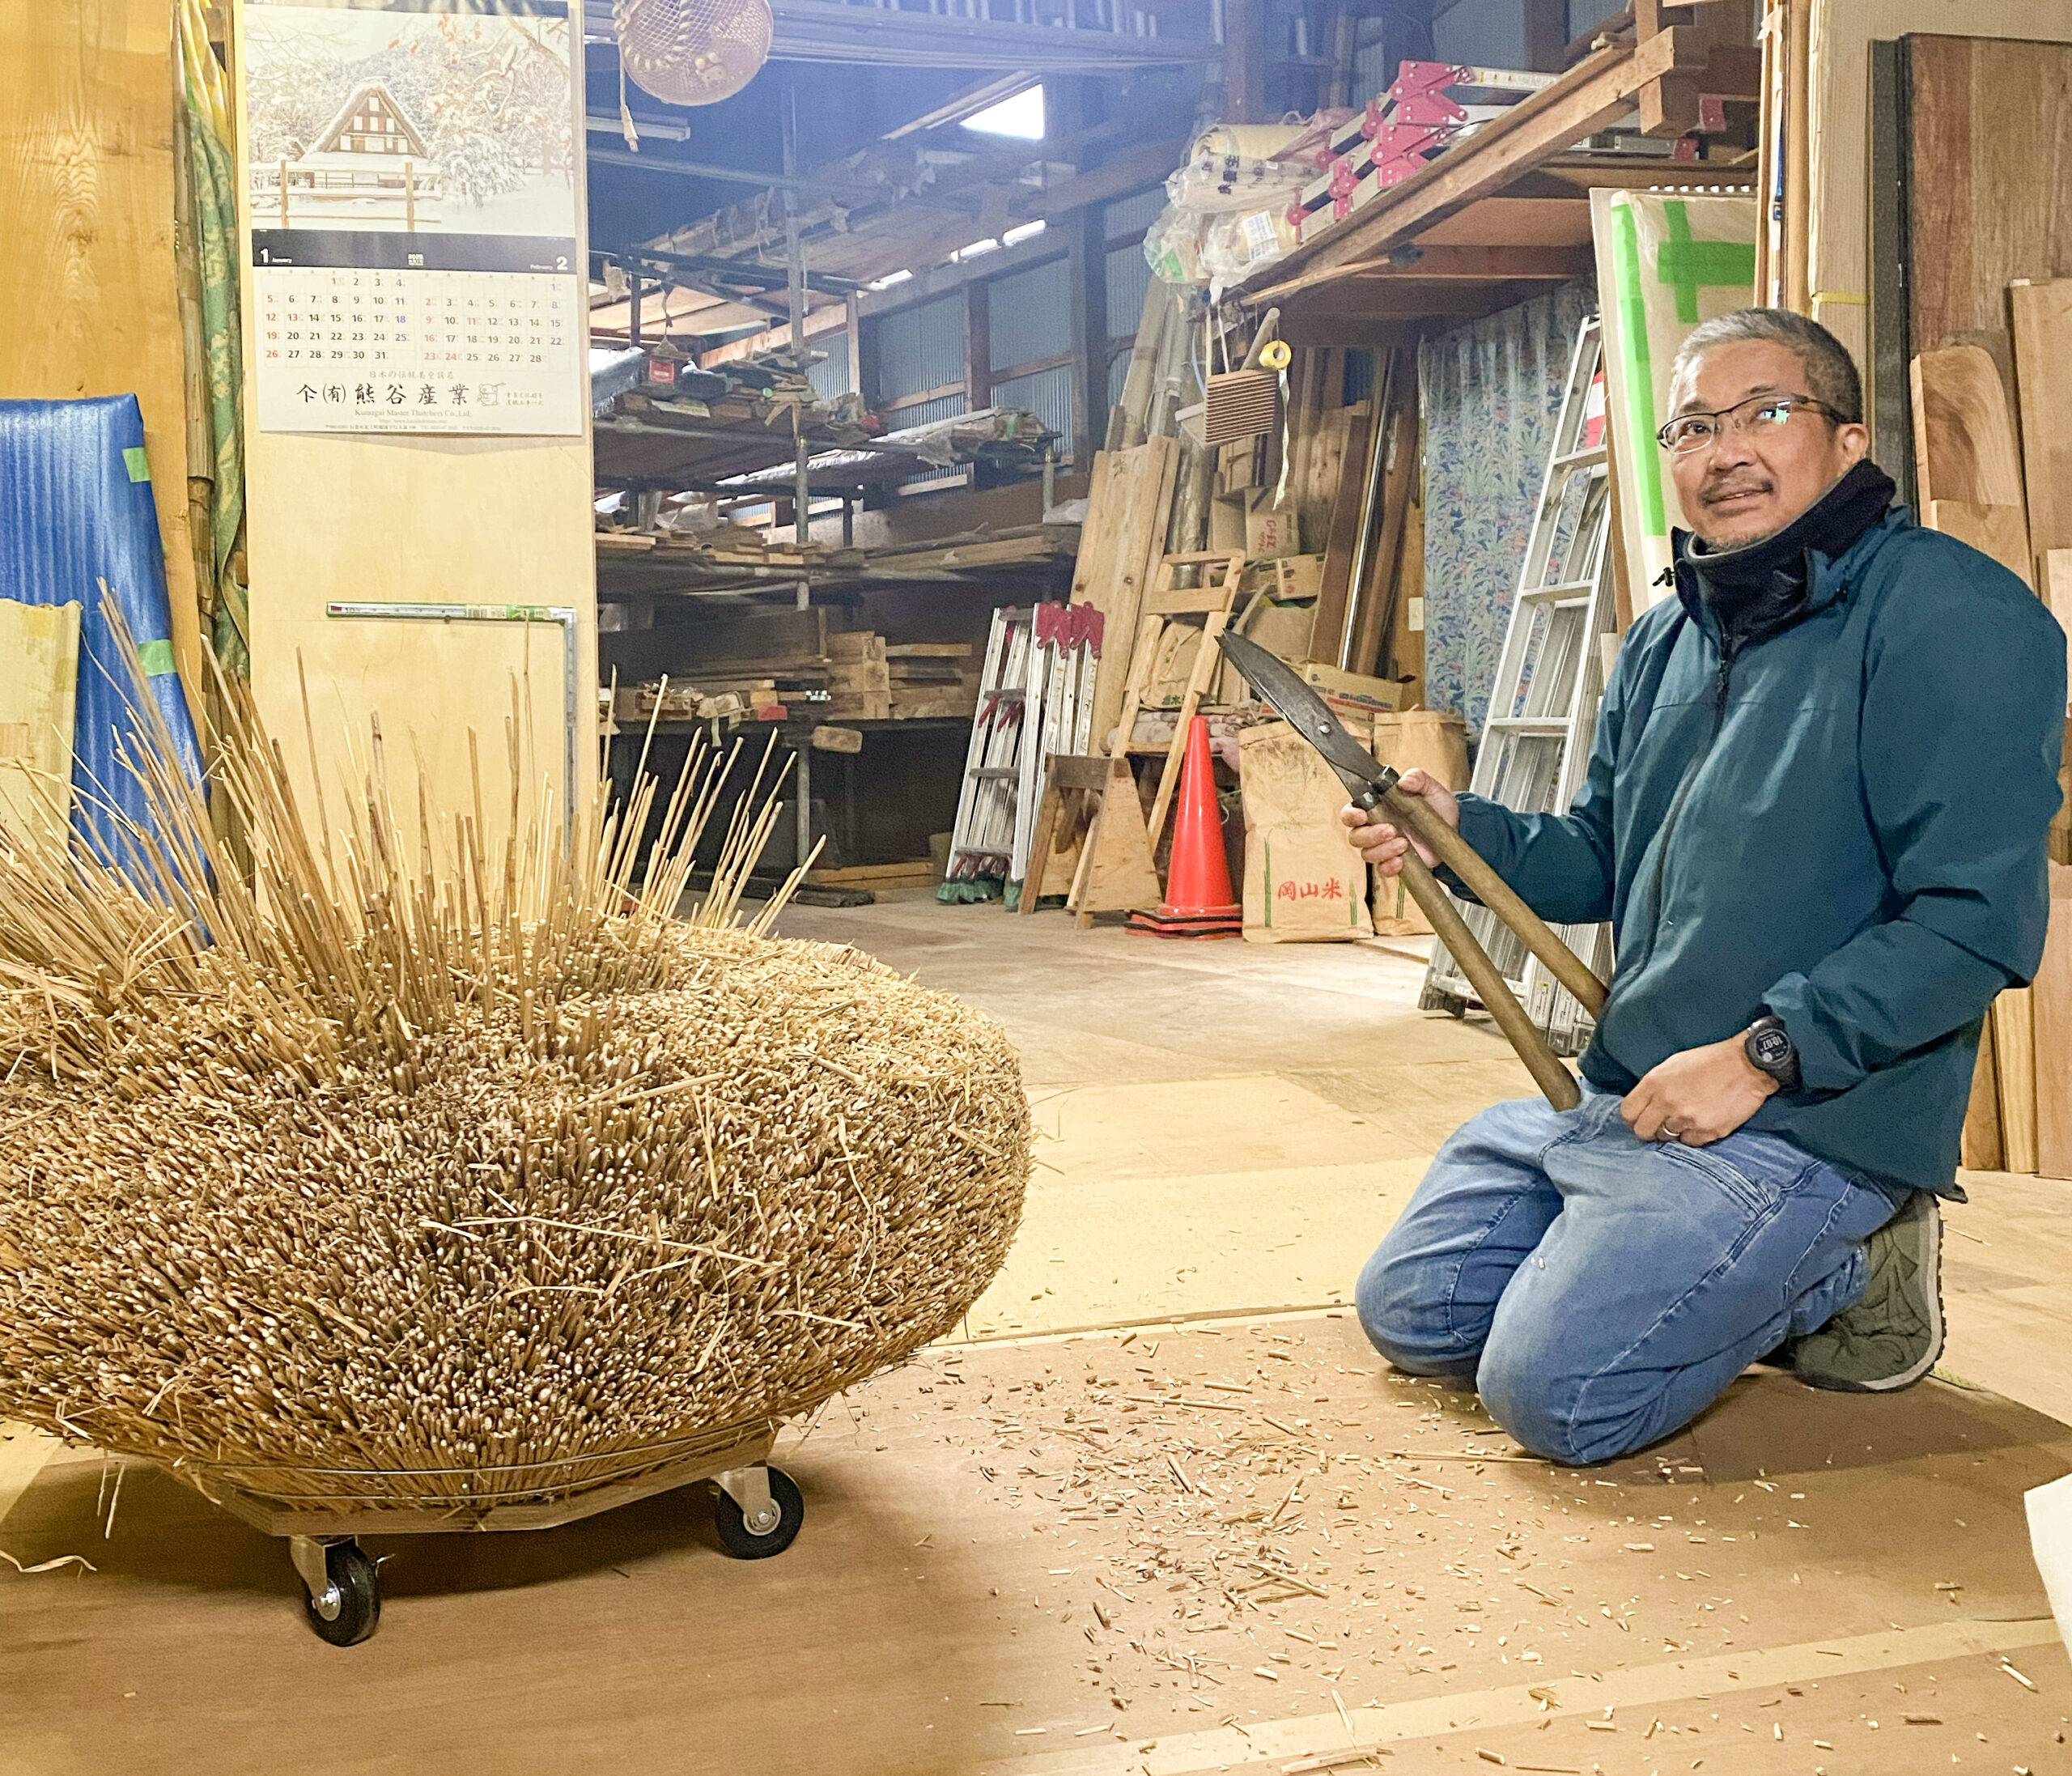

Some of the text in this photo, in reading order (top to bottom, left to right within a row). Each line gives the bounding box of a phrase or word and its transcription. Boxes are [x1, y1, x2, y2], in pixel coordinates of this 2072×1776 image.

[259, 248, 270, 264] 1
[556, 256, 568, 271] 2
[330, 277, 402, 287] 1 2 3 4
[551, 283, 556, 292] 1
[267, 295, 405, 305] 5 6 7 8 9 10 11
[425, 297, 558, 309] 2 3 4 5 6 7 8
[265, 312, 406, 324] 12 13 14 15 16 17 18
[425, 315, 561, 328] 9 10 11 12 13 14 15
[266, 331, 407, 342] 19 20 21 22 23 24 25
[424, 334, 563, 346] 16 17 18 19 20 21 22
[265, 350, 386, 359] 26 27 28 29 30 31
[423, 351, 542, 363] 23 24 25 26 27 28
[355, 409, 385, 418] Kumagai
[386, 409, 410, 417] Master
[410, 409, 444, 417] Thatchers
[1277, 877, 1343, 901] 岡山米
